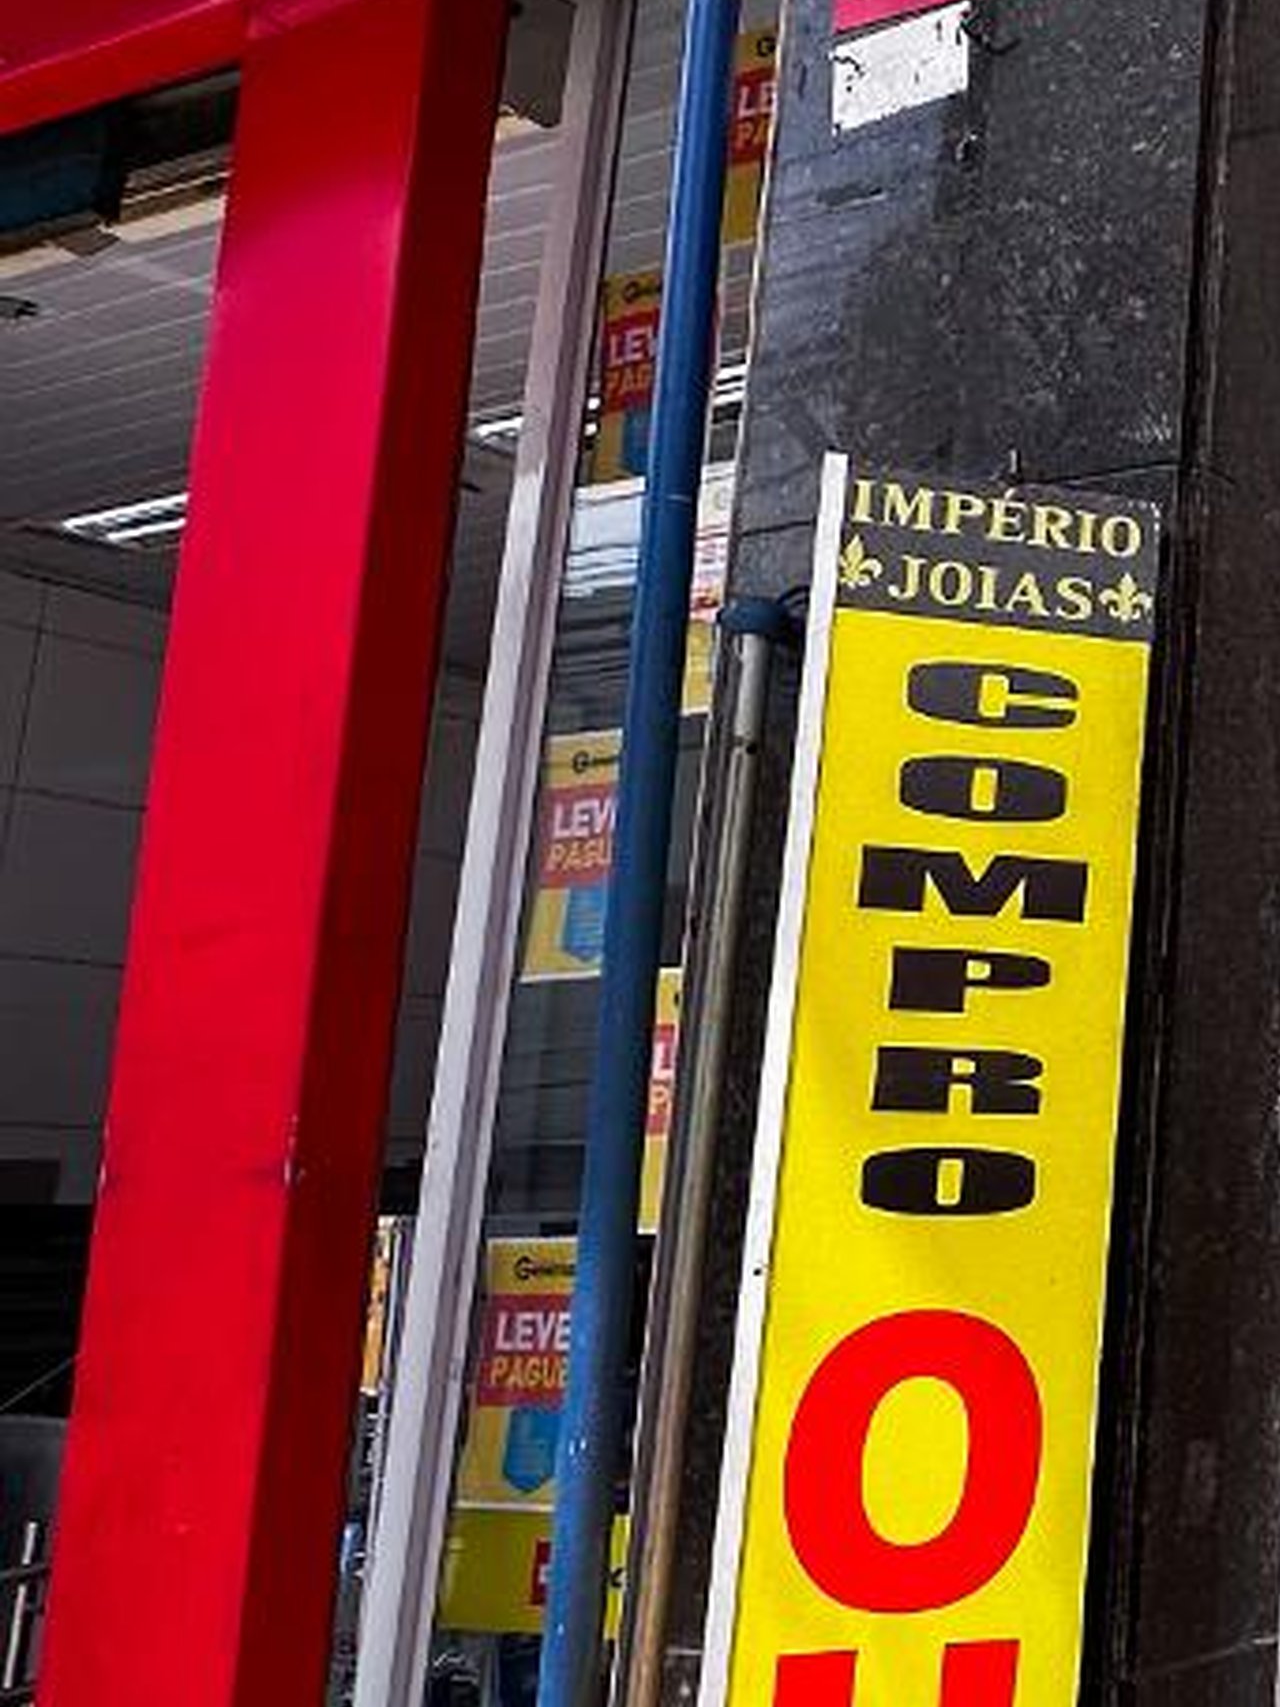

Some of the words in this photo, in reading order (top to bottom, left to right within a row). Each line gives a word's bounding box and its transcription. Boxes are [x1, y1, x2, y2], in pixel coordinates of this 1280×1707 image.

[852, 479, 1144, 558] IMPÉRIO
[888, 552, 1096, 621] JOIAS
[857, 660, 1090, 1218] COMPRO
